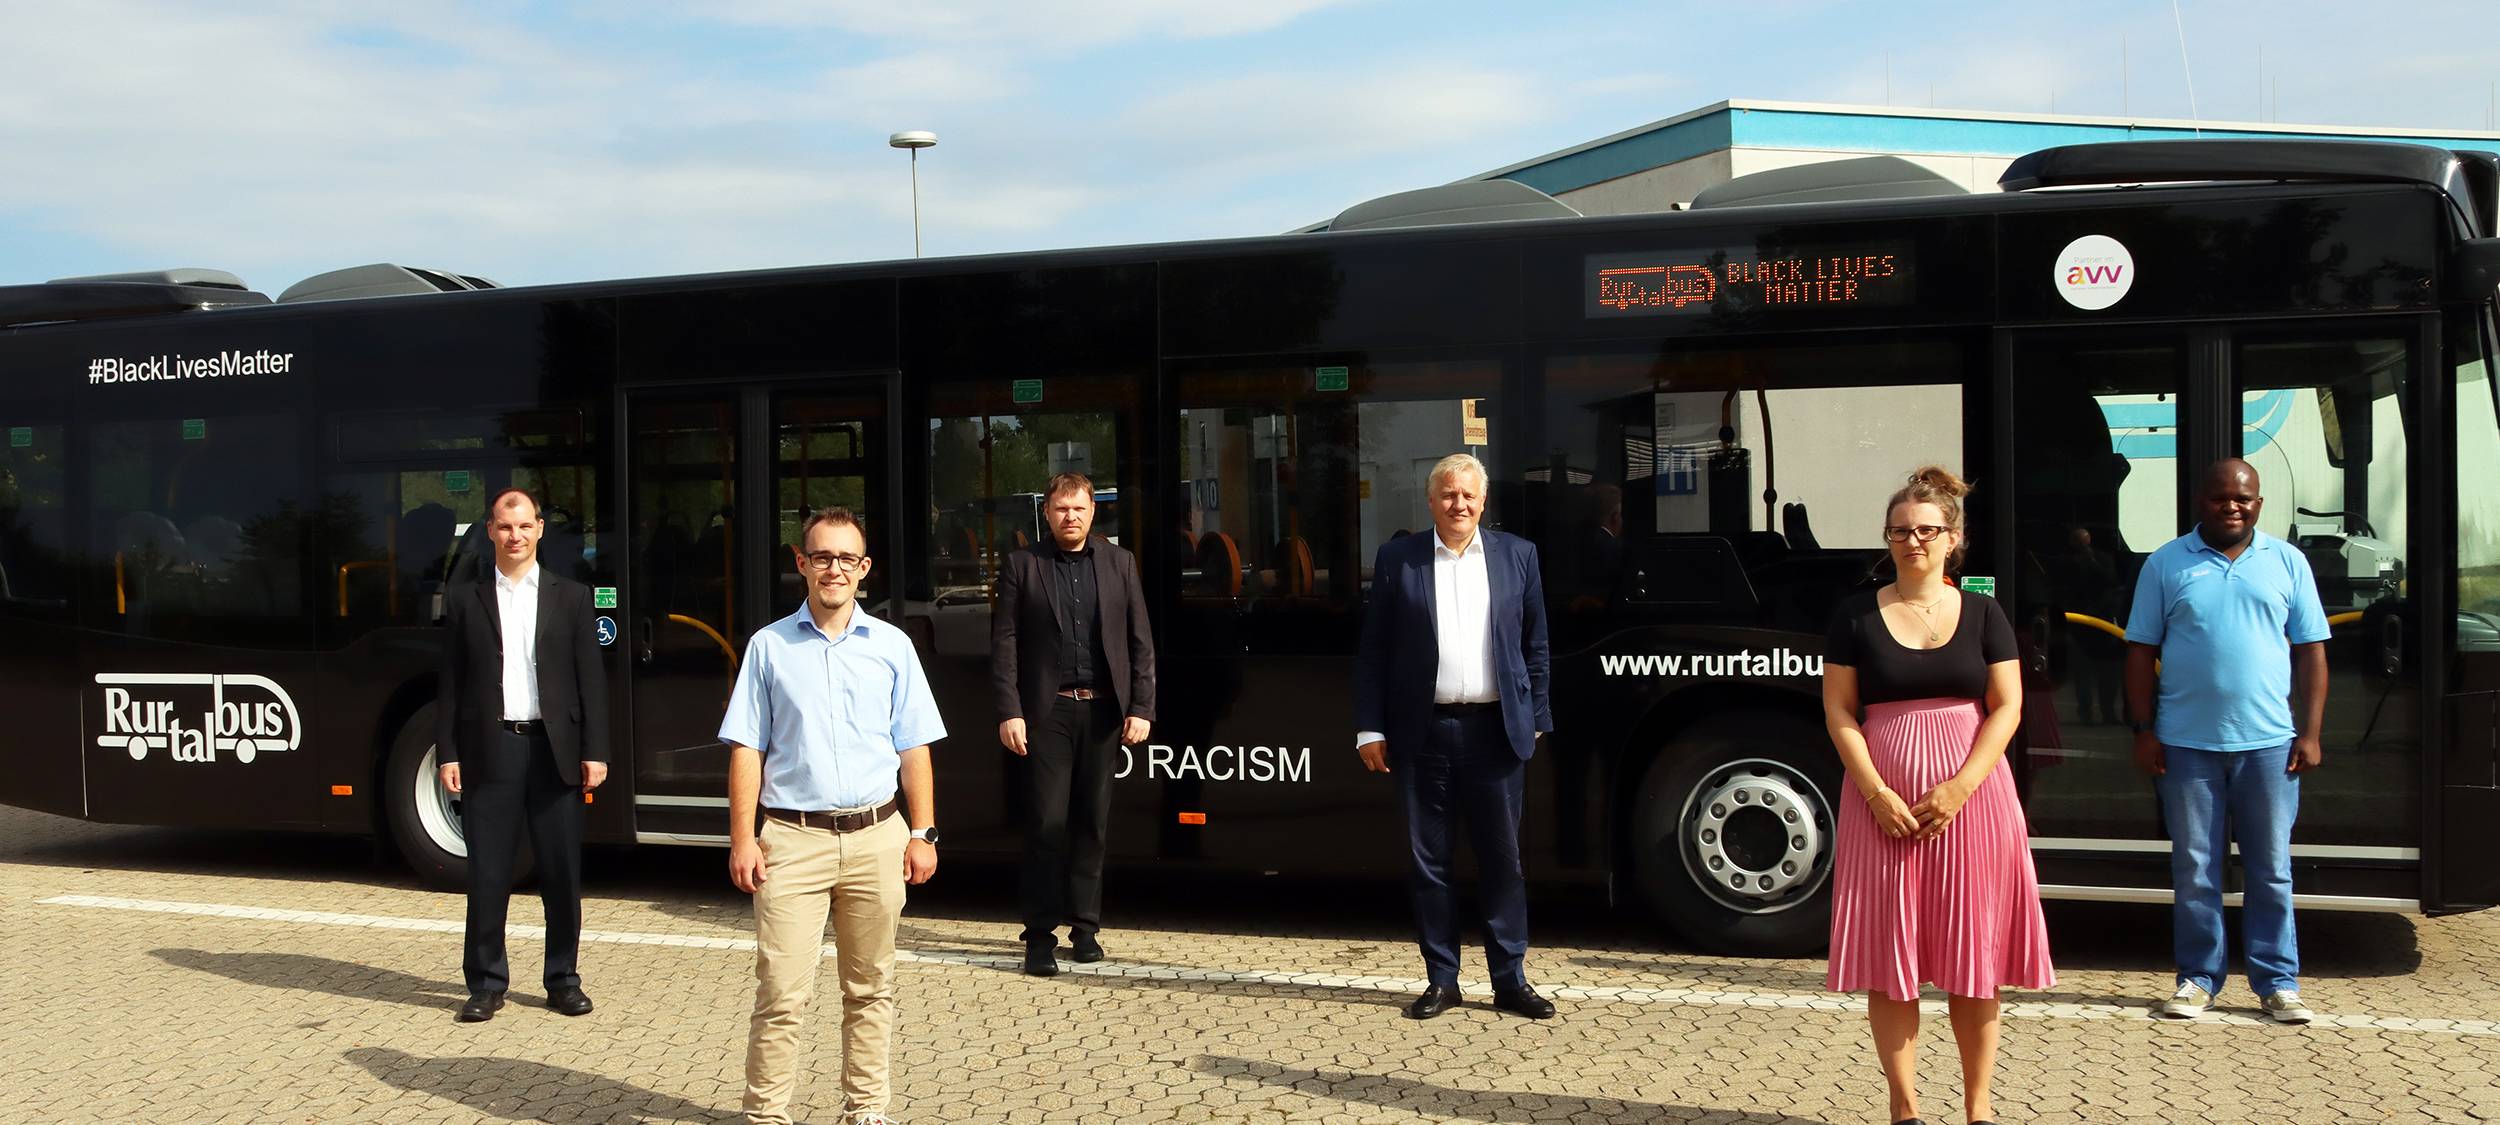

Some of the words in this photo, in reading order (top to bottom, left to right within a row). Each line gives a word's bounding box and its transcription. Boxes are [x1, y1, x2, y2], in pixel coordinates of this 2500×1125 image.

[1728, 259, 1803, 284] BLACK
[1818, 255, 1894, 281] LIVES
[2067, 264, 2123, 285] avv
[1766, 279, 1858, 304] MATTER
[88, 349, 294, 385] #BlackLivesMatter
[1600, 648, 1824, 677] www.rurtalbu
[1148, 744, 1311, 783] RACISM
